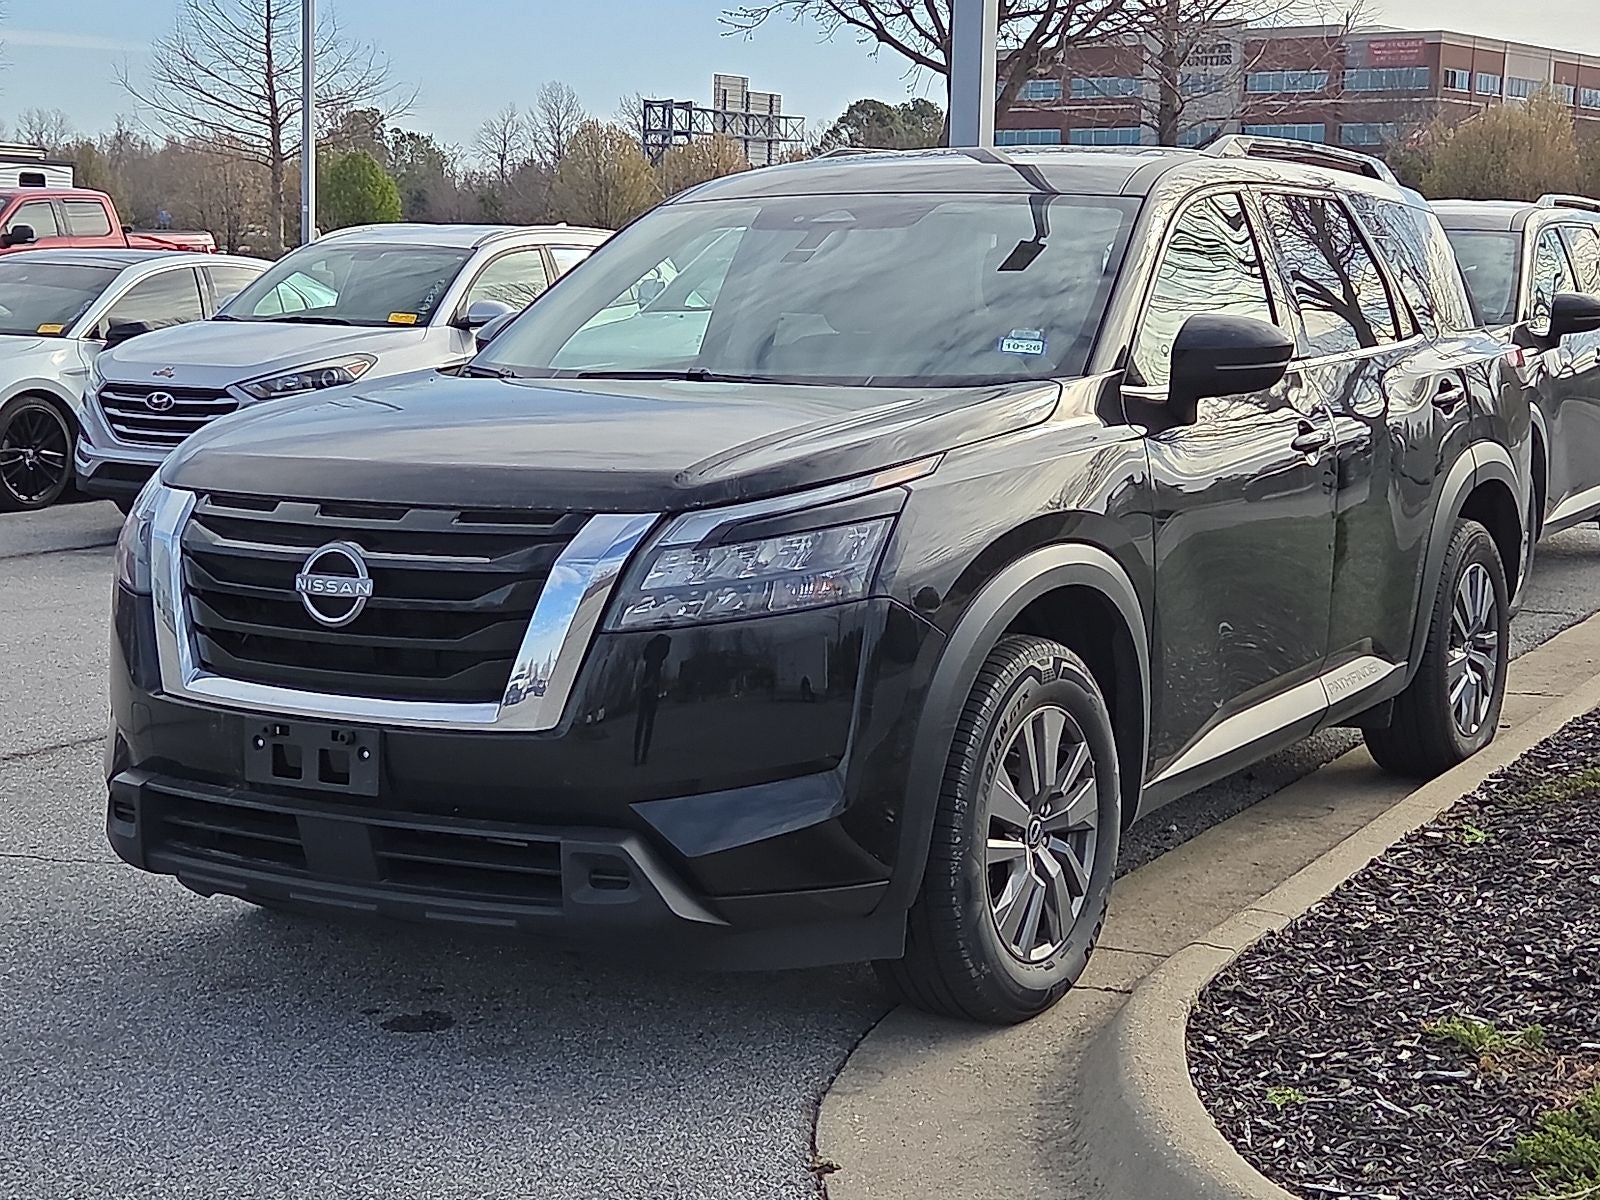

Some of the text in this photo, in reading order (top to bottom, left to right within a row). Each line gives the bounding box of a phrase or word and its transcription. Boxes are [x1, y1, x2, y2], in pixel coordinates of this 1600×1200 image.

[1183, 54, 1232, 67] UNITIES
[296, 577, 371, 595] NISSAN
[1326, 661, 1381, 695] PATHFINDER
